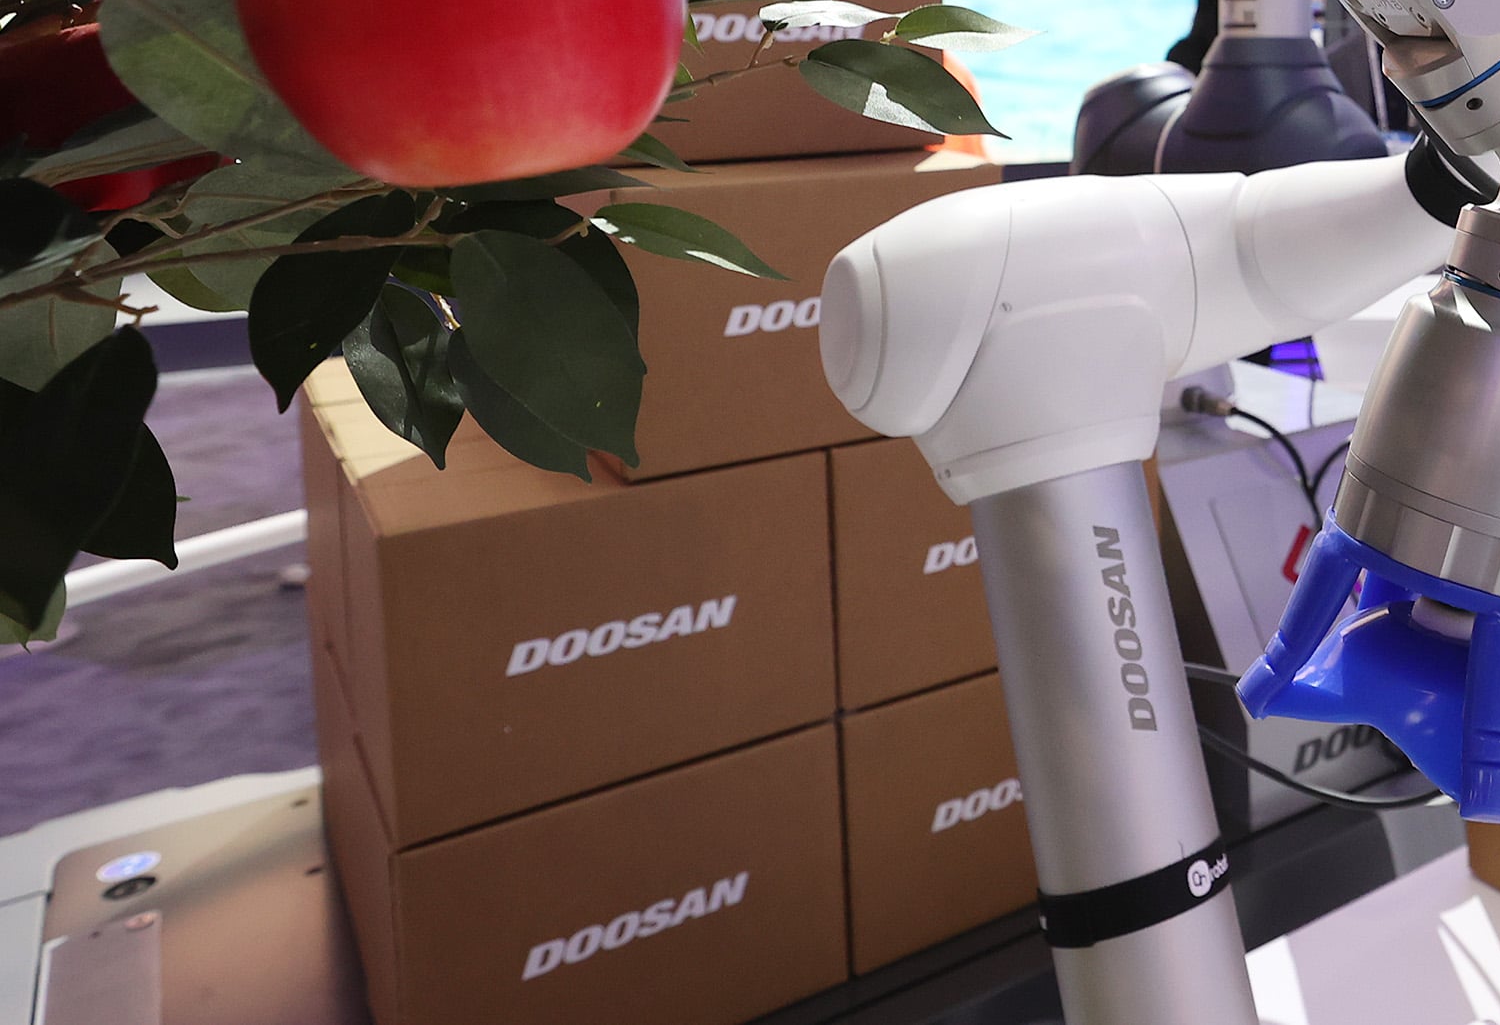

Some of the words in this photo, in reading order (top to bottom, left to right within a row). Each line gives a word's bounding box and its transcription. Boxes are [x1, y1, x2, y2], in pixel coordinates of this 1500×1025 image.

[724, 296, 821, 337] DOO
[506, 595, 737, 677] DOOSAN
[1093, 526, 1157, 731] DOOSAN
[931, 778, 1023, 833] DOO
[521, 871, 748, 981] DOOSAN
